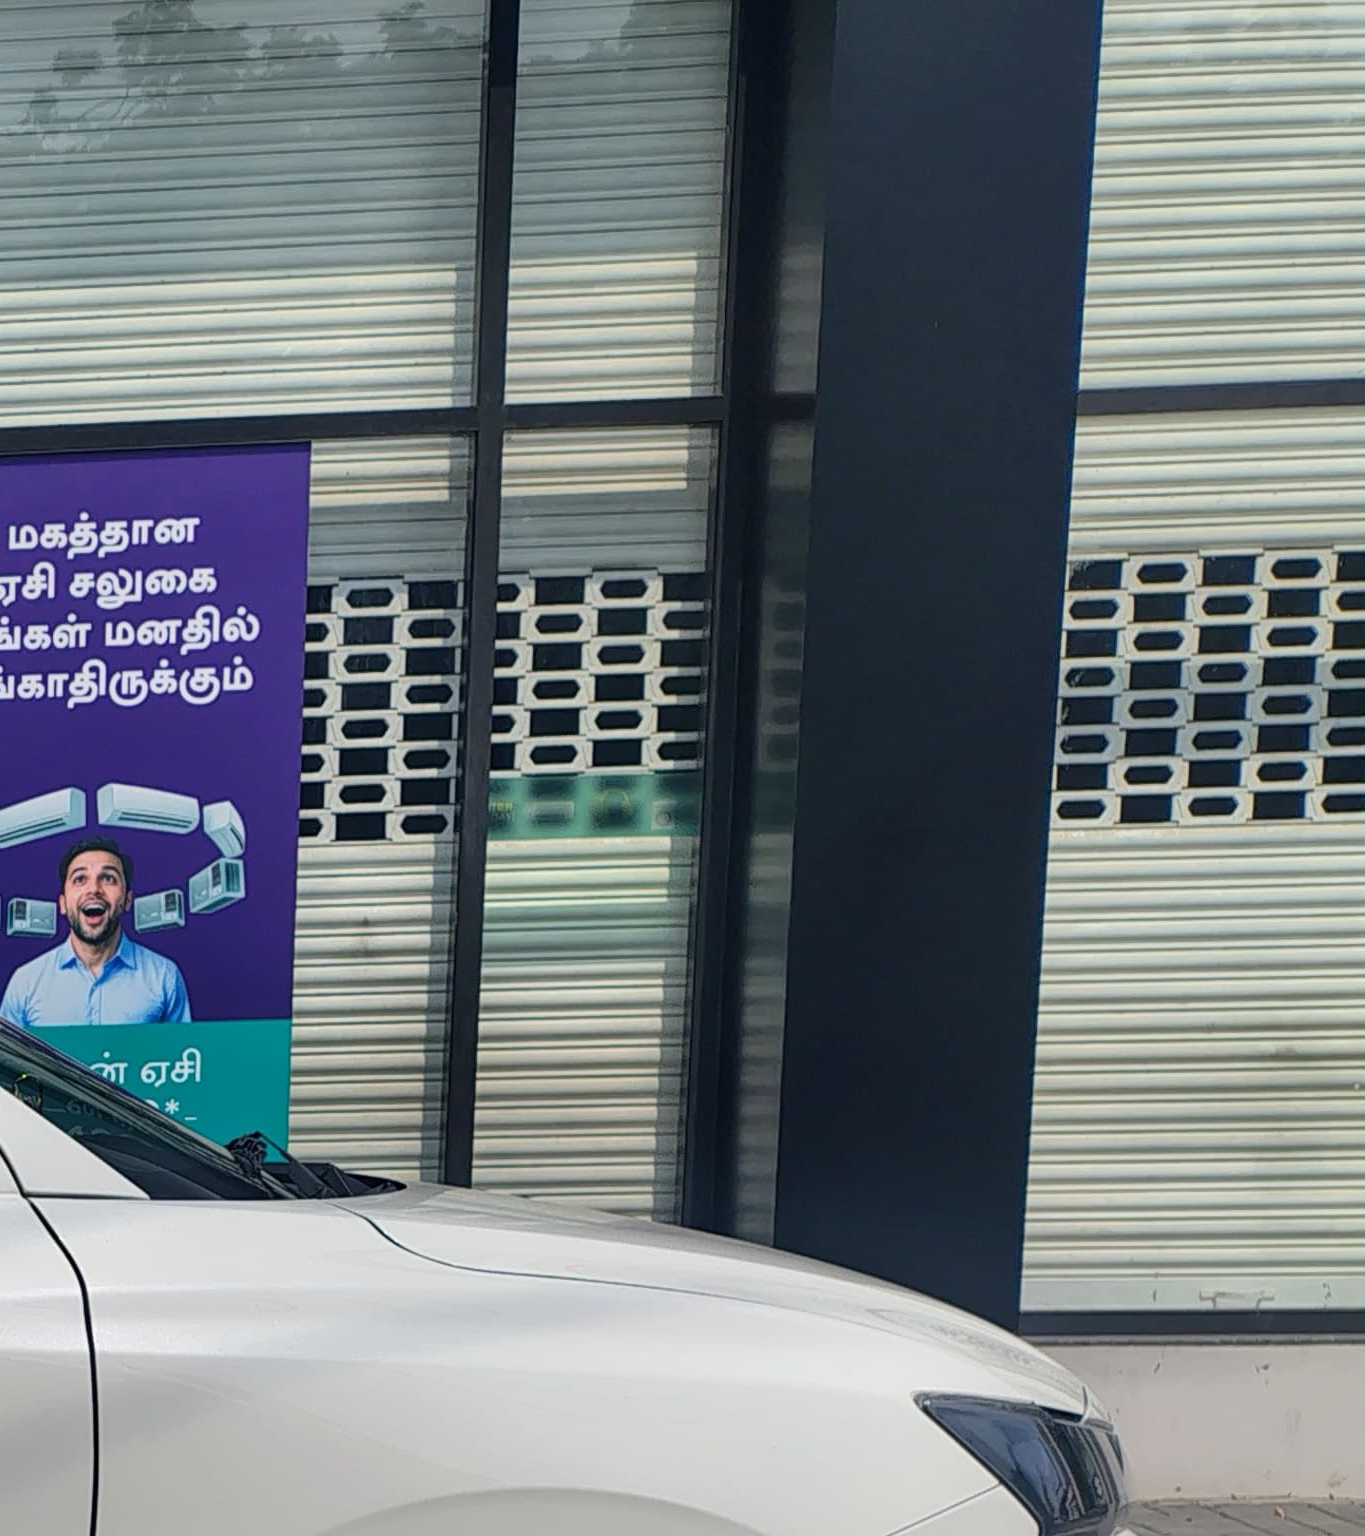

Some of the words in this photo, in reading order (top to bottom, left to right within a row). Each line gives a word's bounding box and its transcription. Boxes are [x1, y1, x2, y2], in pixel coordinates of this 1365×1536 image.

[7, 511, 200, 560] மகத்தான
[68, 566, 218, 610] சலுகை
[104, 605, 260, 656] மனதில்
[139, 1047, 202, 1088] ஏசி
